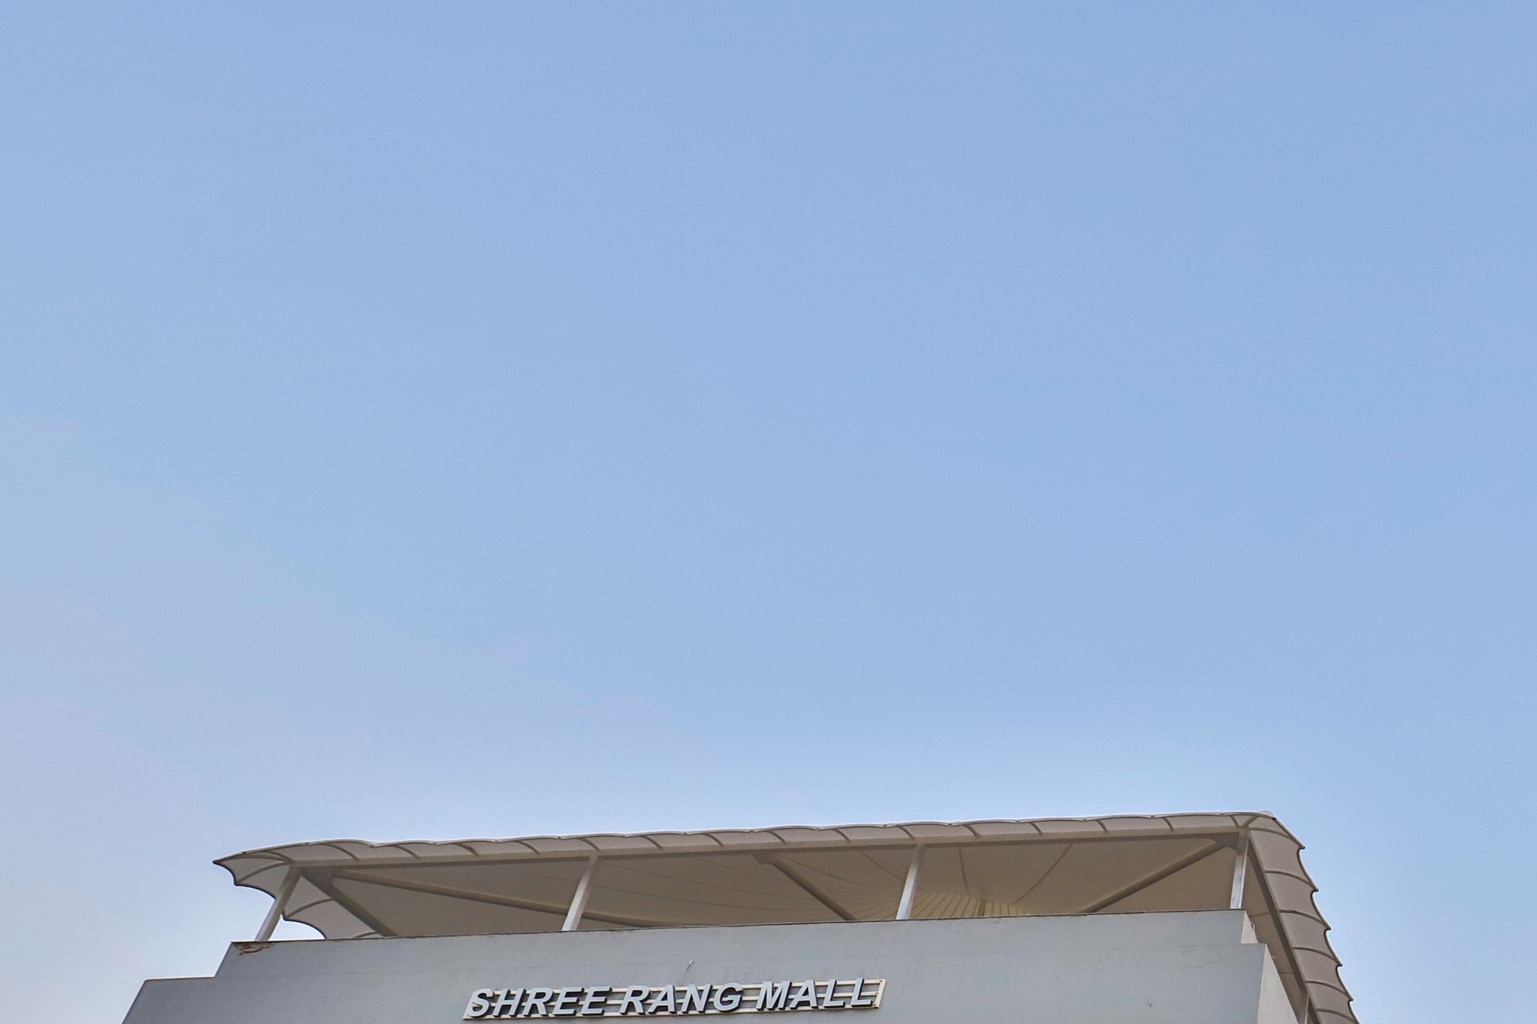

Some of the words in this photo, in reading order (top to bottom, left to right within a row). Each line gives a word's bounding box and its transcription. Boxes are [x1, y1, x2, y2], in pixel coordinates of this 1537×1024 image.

[469, 987, 612, 1018] SHREE
[618, 984, 745, 1014] RANG
[755, 977, 878, 1009] MALL
